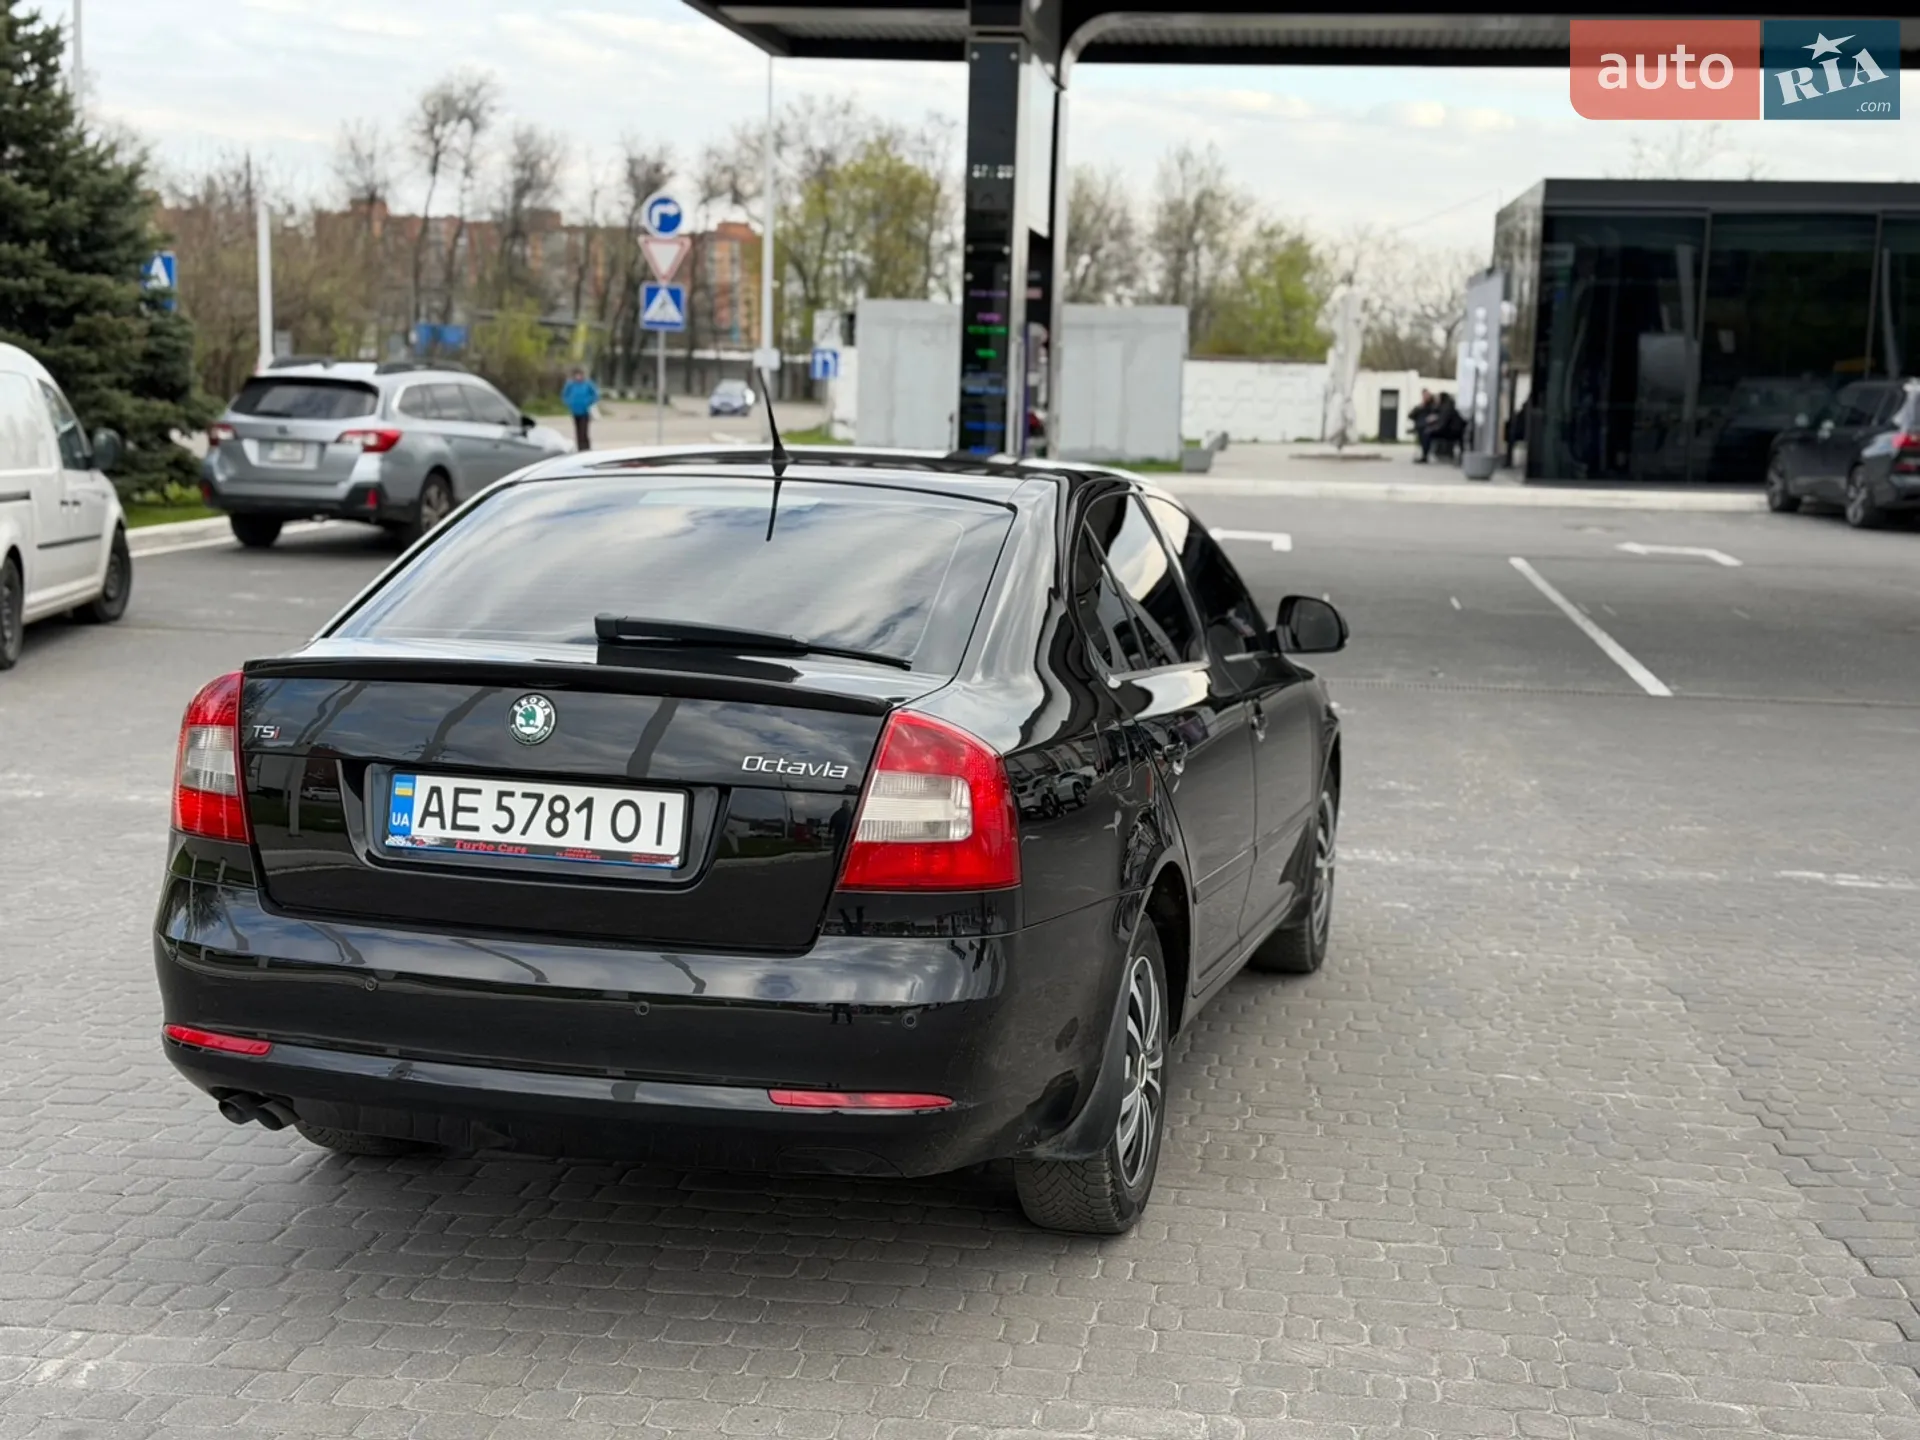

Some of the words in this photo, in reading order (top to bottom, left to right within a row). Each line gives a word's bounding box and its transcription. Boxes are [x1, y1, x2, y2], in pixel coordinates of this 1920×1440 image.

[253, 725, 280, 739] TSI
[741, 755, 849, 779] Octavia
[391, 811, 410, 827] UA
[417, 785, 483, 833] AE
[491, 790, 595, 841] 5781
[456, 840, 495, 852] Turbo
[498, 843, 529, 855] Cars
